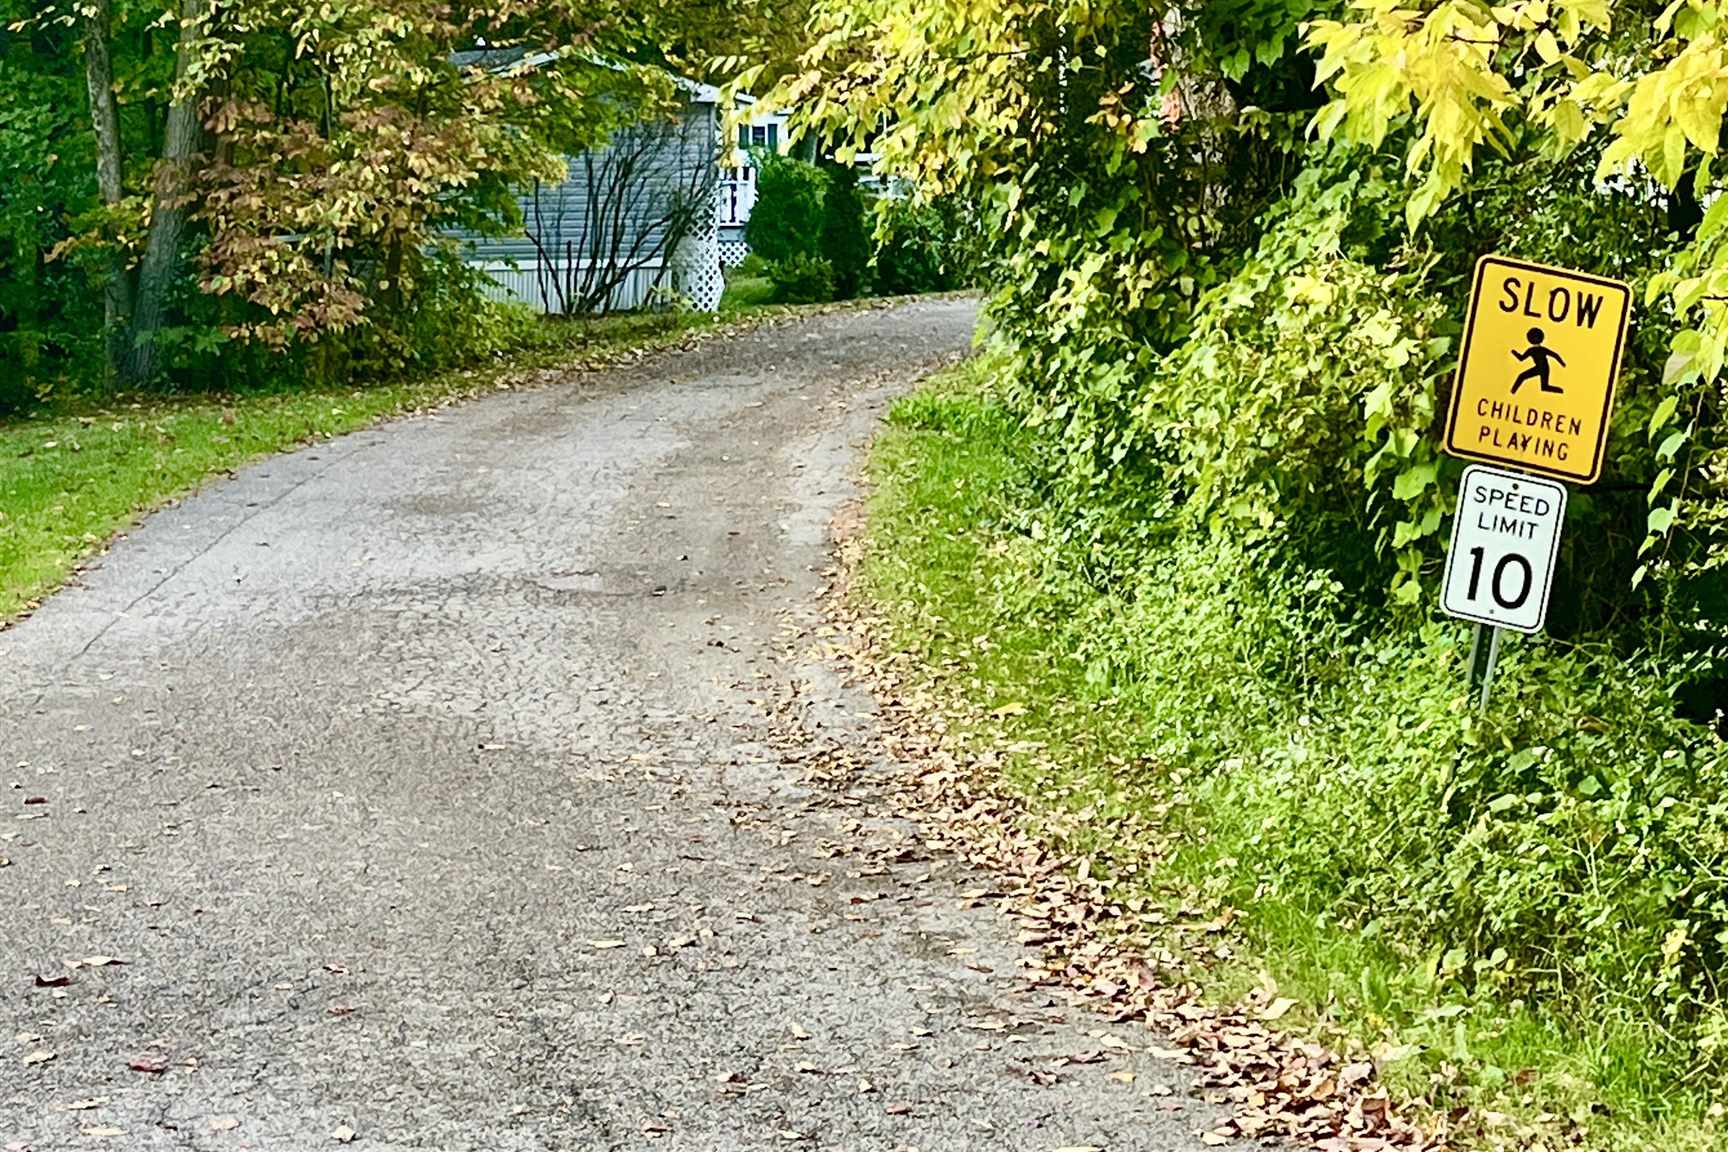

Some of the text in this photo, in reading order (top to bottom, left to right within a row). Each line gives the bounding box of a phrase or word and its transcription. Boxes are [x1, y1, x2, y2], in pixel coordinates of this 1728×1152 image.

[1499, 277, 1604, 329] SLOW
[1477, 398, 1582, 436] CHILDREN
[1478, 425, 1569, 461] PLAYING
[1473, 485, 1550, 516] SPEED
[1477, 511, 1539, 540] LIMIT
[1466, 546, 1533, 610] 10
